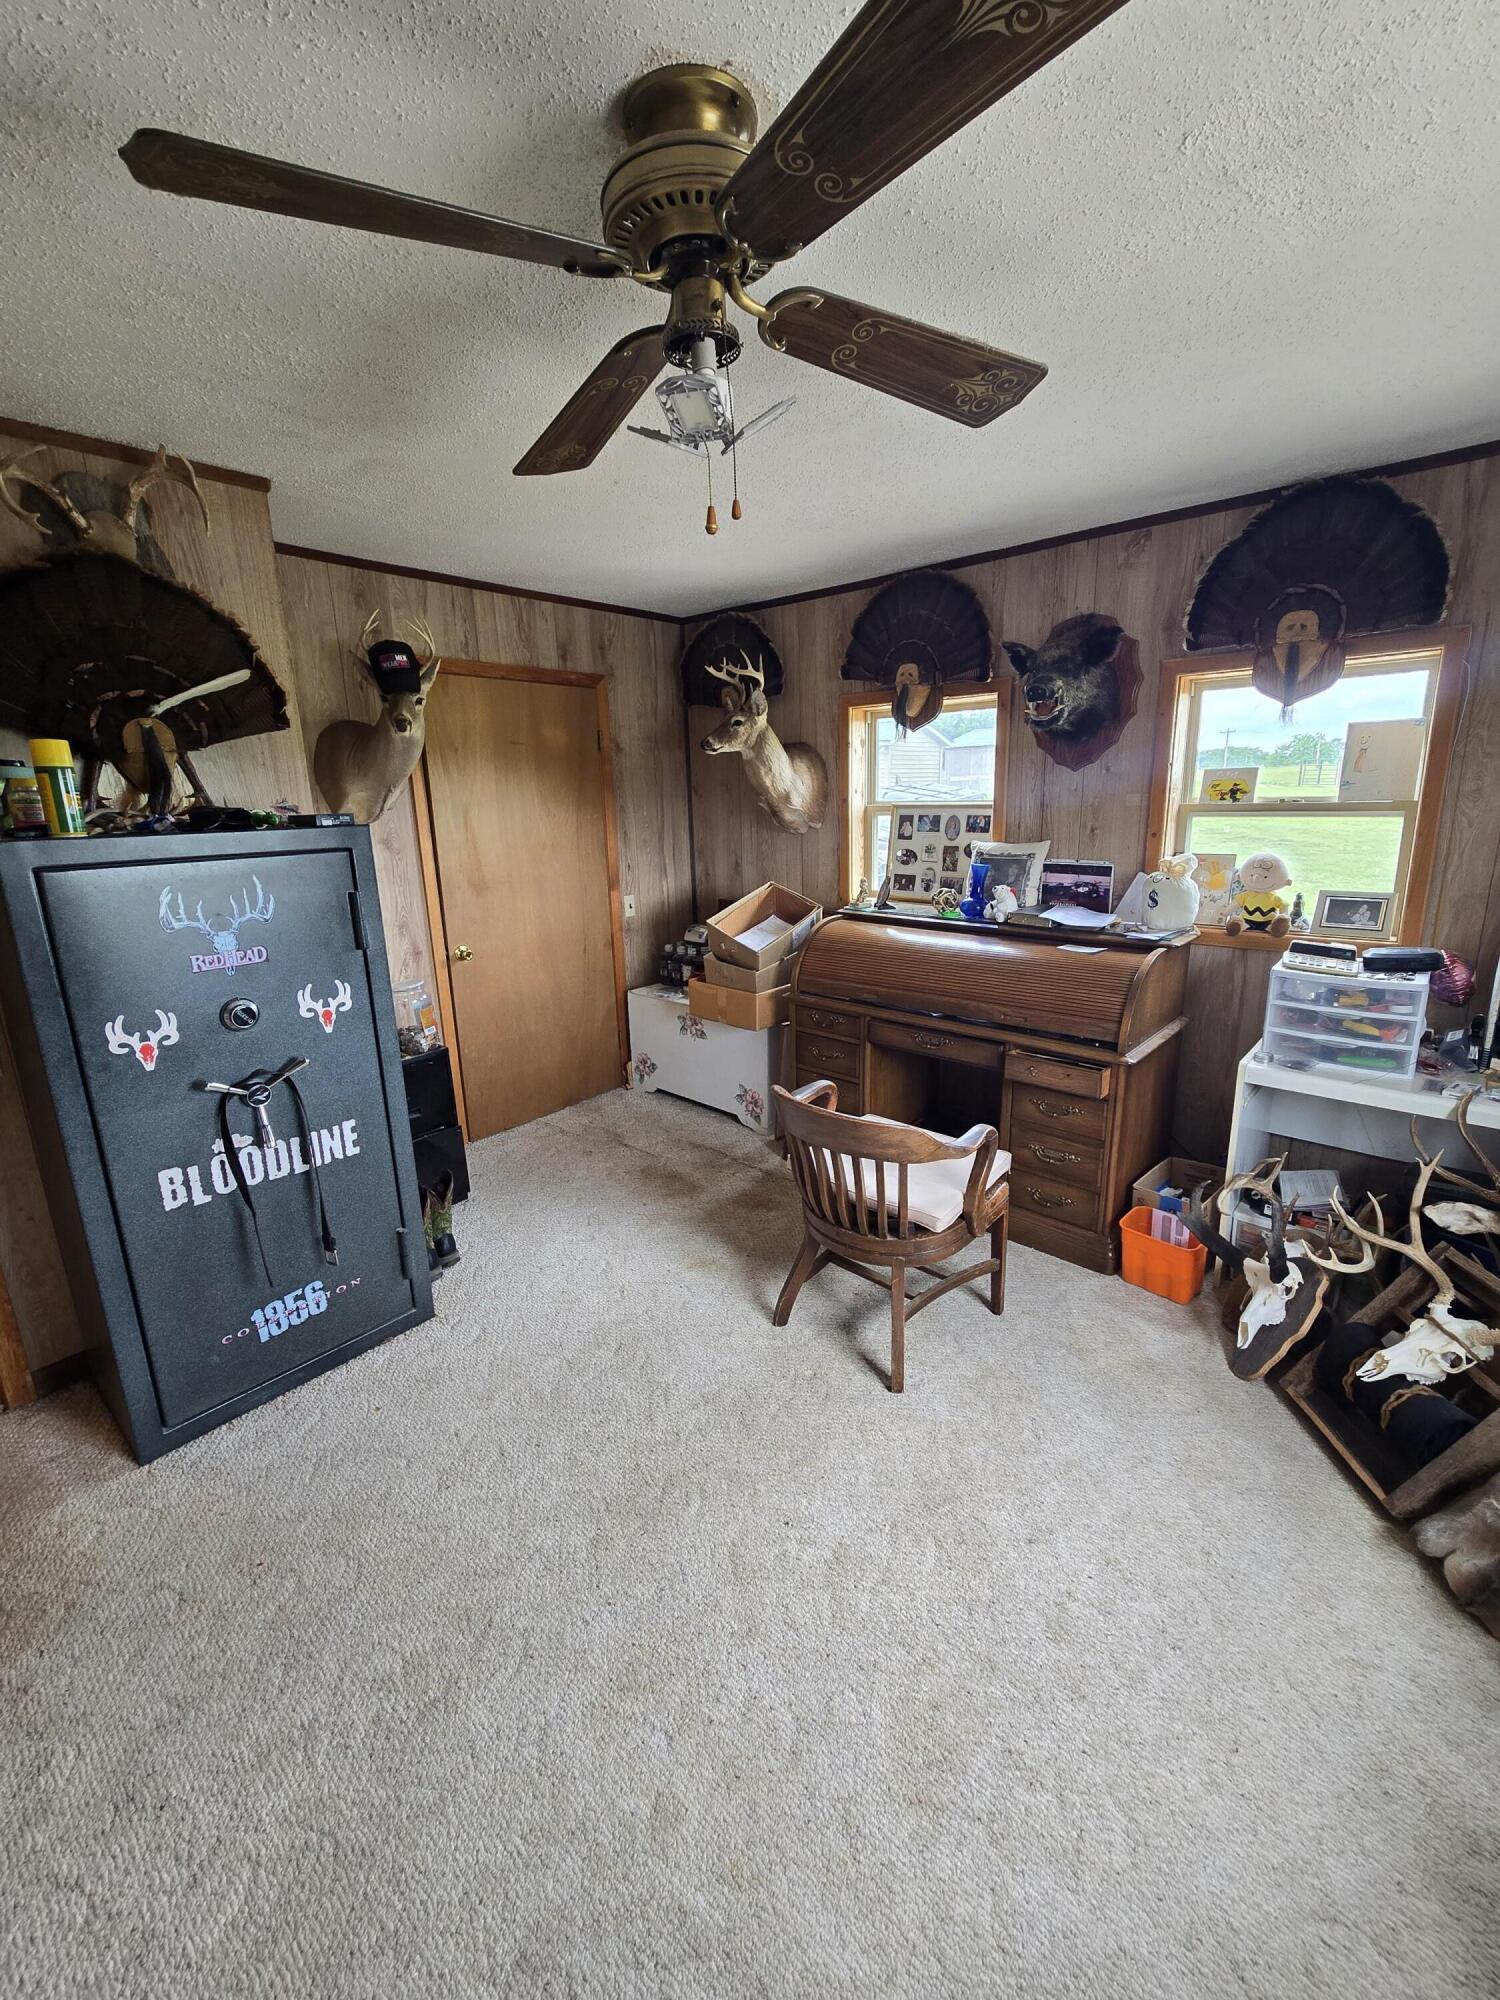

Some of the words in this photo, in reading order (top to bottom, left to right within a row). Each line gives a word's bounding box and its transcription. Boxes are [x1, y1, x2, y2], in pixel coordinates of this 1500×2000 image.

[189, 945, 268, 974] REDHEAD
[157, 1118, 361, 1212] BLOODLINE
[250, 1280, 329, 1343] 1856
